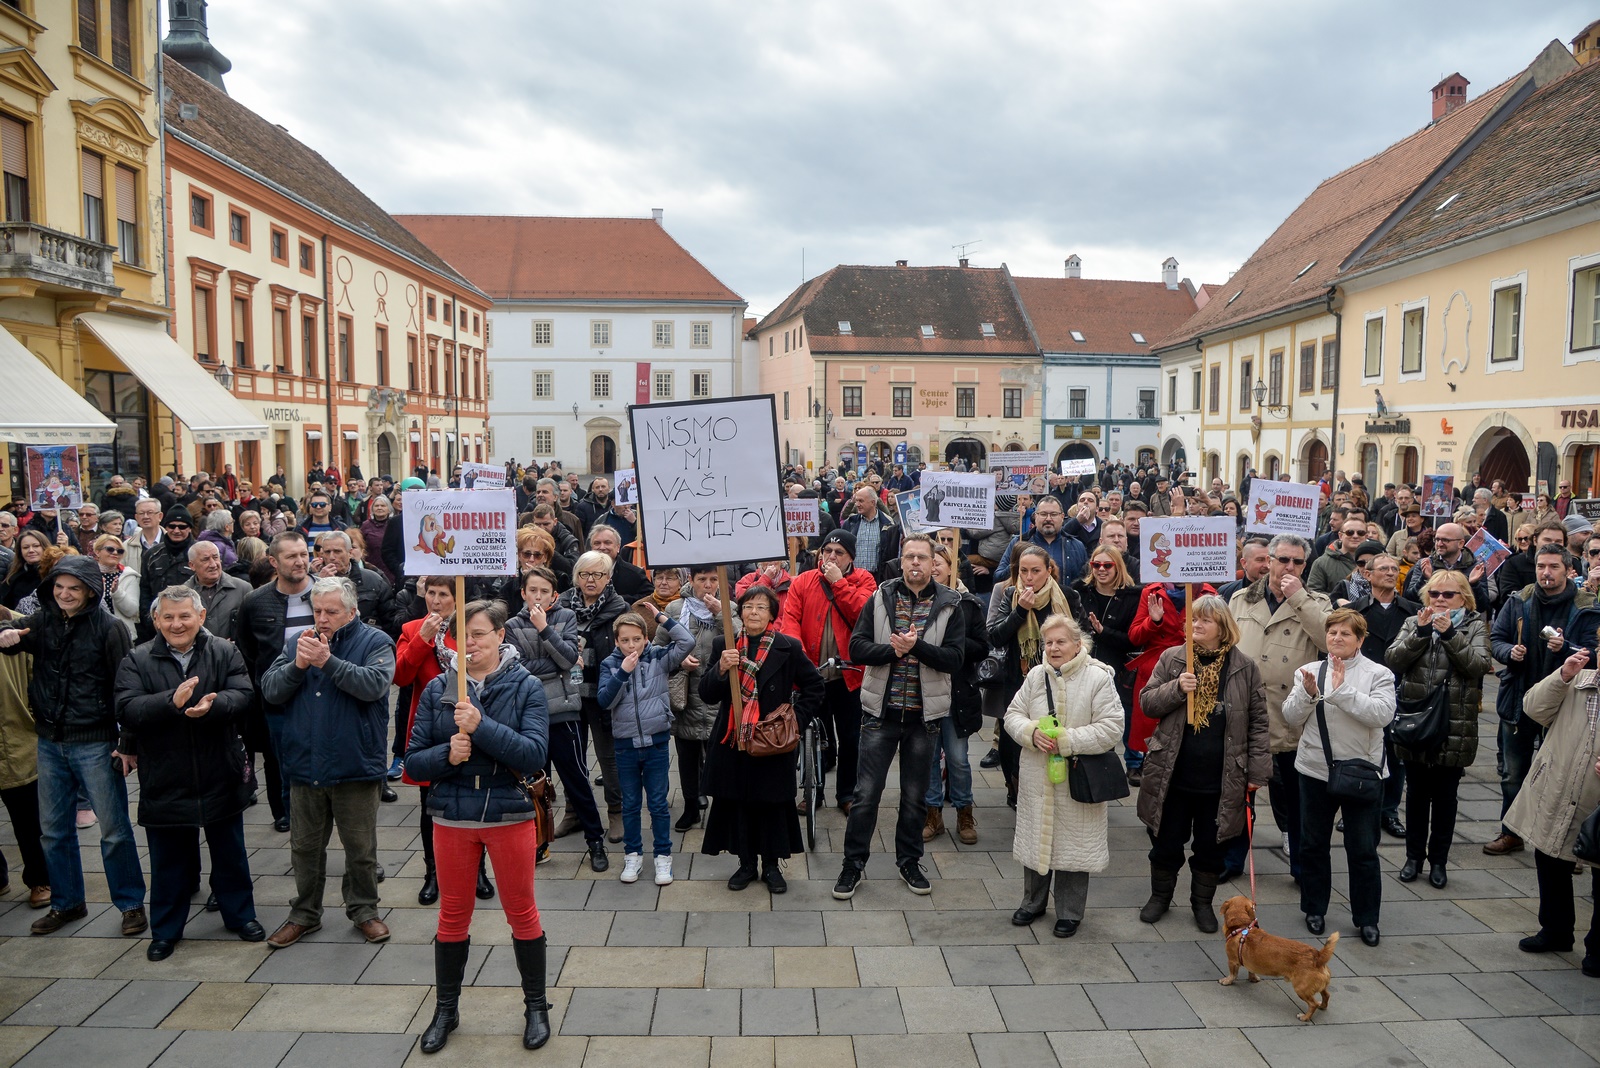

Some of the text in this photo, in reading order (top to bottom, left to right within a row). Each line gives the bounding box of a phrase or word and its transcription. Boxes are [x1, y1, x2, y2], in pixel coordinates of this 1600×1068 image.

[919, 389, 949, 398] Centar
[263, 408, 300, 421] VARTEKS
[1560, 409, 1600, 428] TISA
[684, 447, 711, 470] MI
[1436, 461, 1451, 470] FOTO
[654, 472, 728, 501] VAŠI
[414, 498, 465, 515] Varaždinci
[443, 512, 506, 530] BUĐENJE!
[786, 511, 811, 521] ĐENJE!
[662, 505, 780, 544] KMETOVI
[1162, 522, 1206, 535] Varaždinci
[1175, 533, 1227, 547] BUĐENJE!
[461, 557, 507, 565] PRAVEDNE
